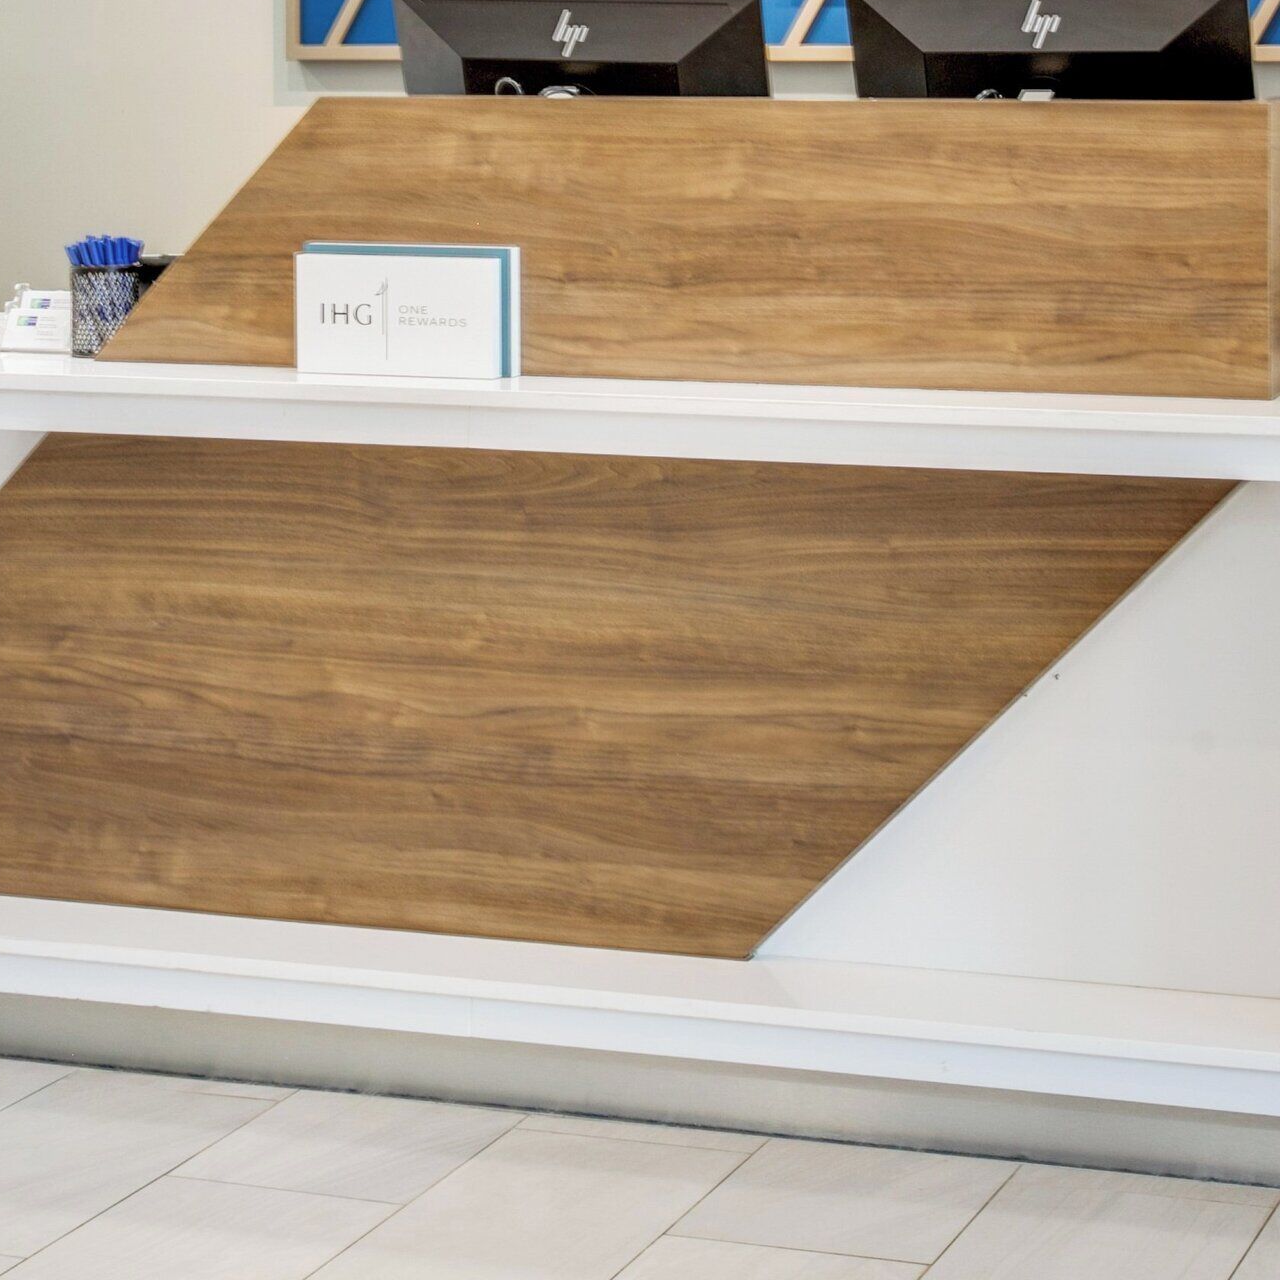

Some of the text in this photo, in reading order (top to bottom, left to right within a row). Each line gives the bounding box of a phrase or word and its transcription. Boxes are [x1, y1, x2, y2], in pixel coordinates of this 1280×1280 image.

[319, 302, 372, 326] IHG
[398, 305, 428, 315] ONE
[398, 316, 468, 328] REWARDS
